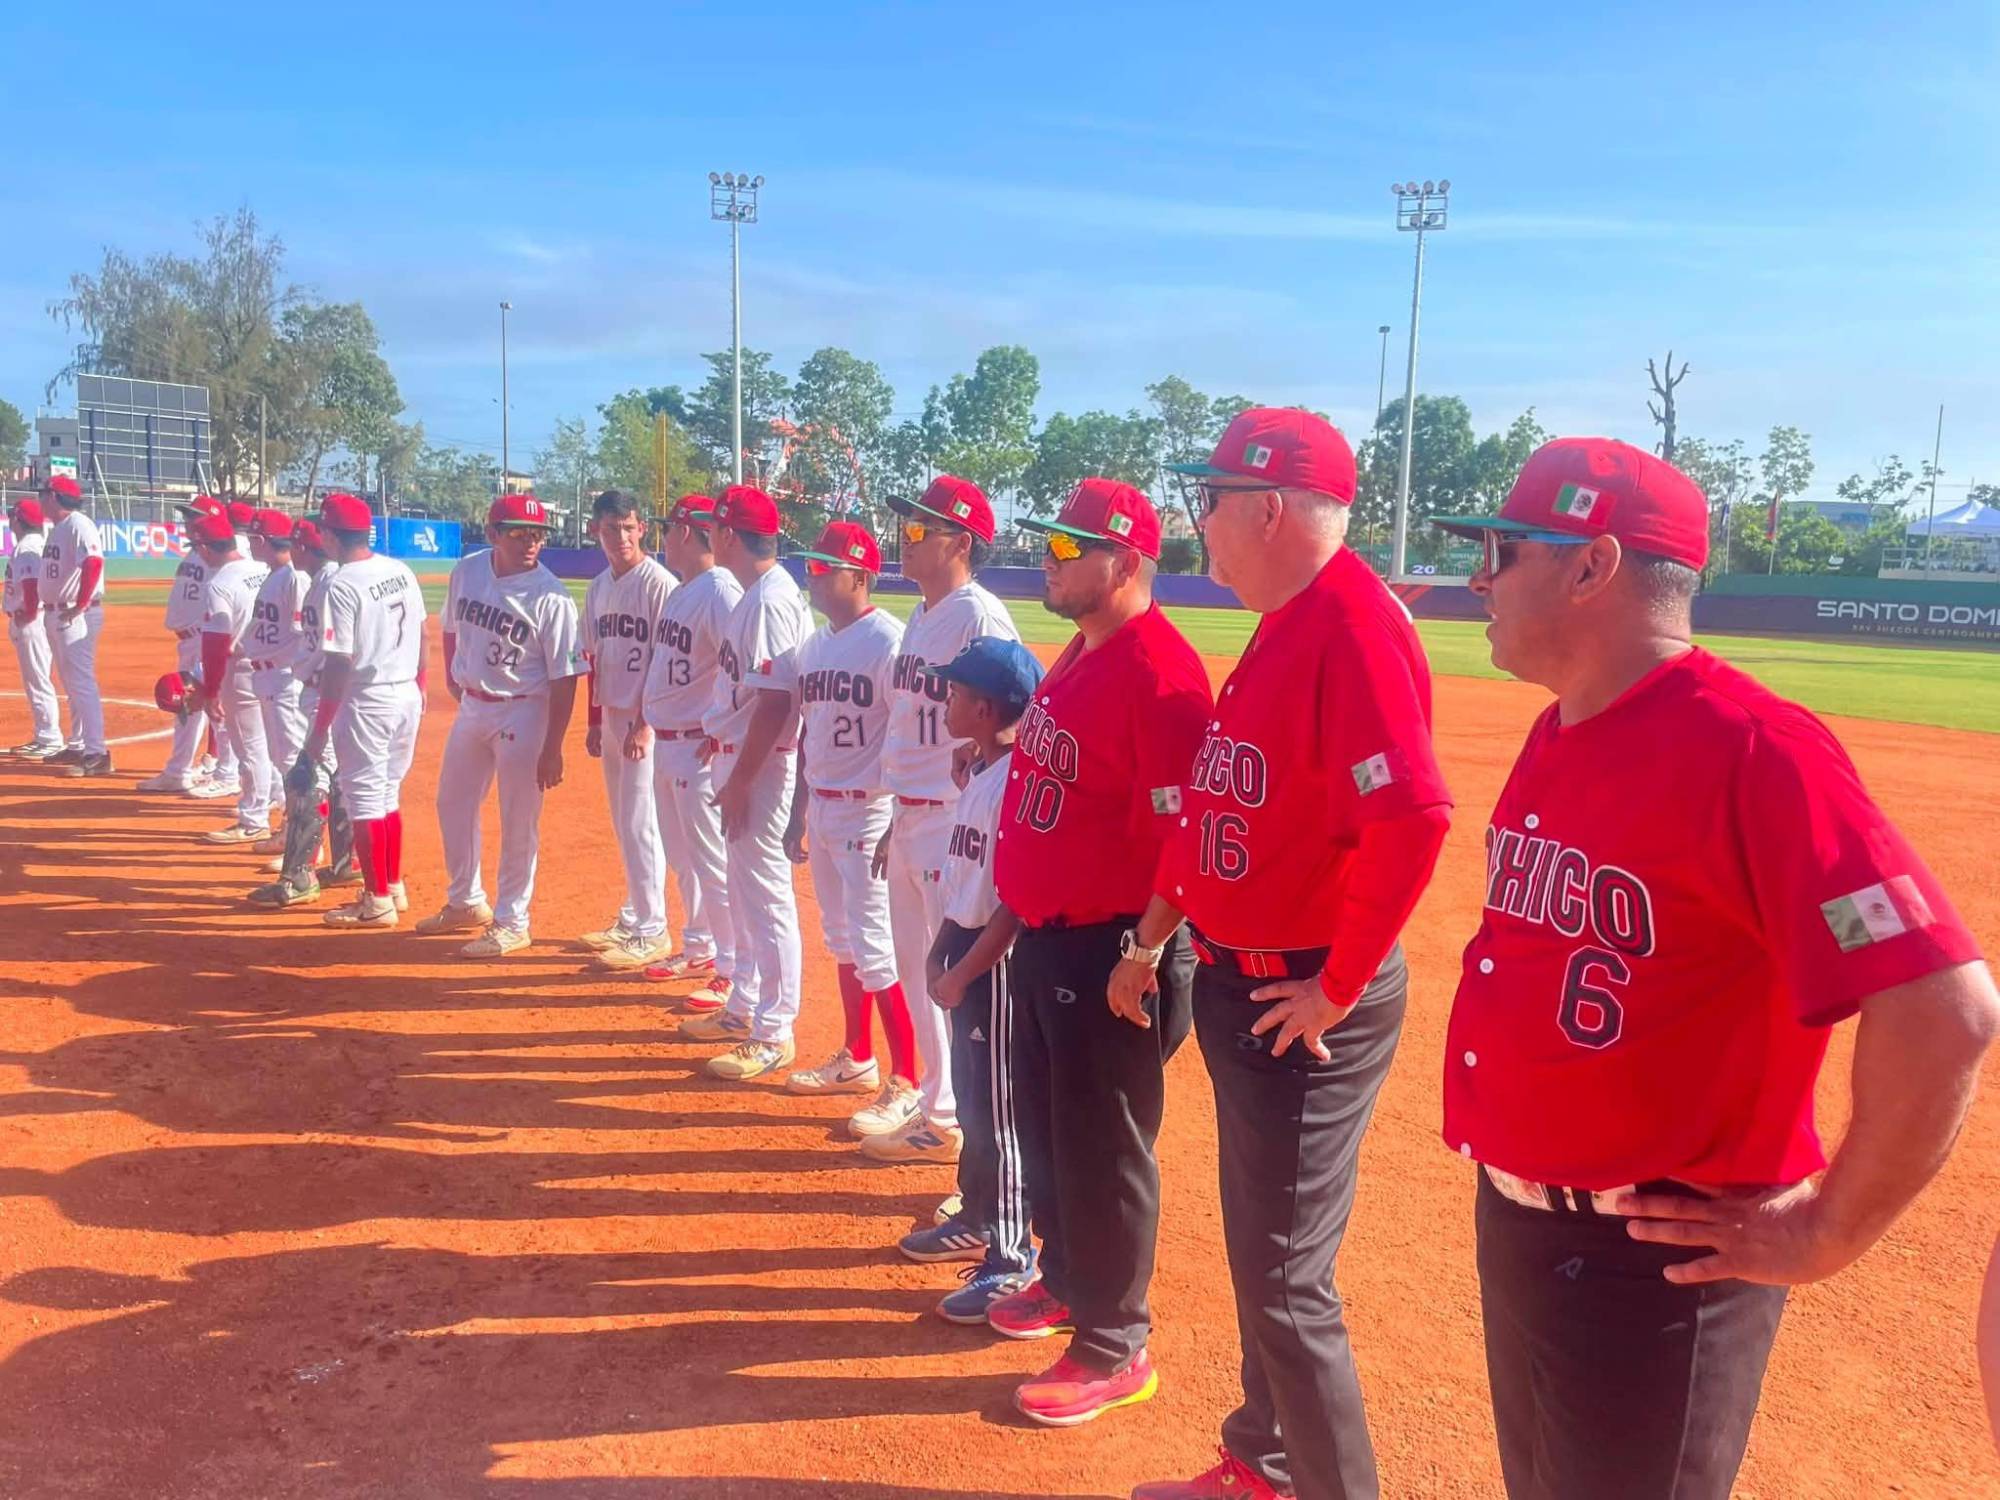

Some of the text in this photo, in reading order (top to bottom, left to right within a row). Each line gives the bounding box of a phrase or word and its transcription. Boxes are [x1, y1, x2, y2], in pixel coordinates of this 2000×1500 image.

[1412, 564, 1435, 574] 20
[184, 583, 199, 600] 12
[369, 574, 408, 601] CARDONA
[390, 601, 405, 648] 7
[1817, 600, 1919, 621] SANTO
[255, 623, 279, 644] 42
[595, 613, 648, 643] EXICO
[485, 641, 518, 671] 34
[627, 647, 641, 672] 2
[668, 659, 690, 686] 13
[799, 670, 873, 708] EXICO
[833, 714, 865, 747] 21
[919, 705, 937, 745] 11
[1016, 770, 1064, 833] 10
[1200, 810, 1249, 881] 16
[1556, 944, 1630, 1050] 6
